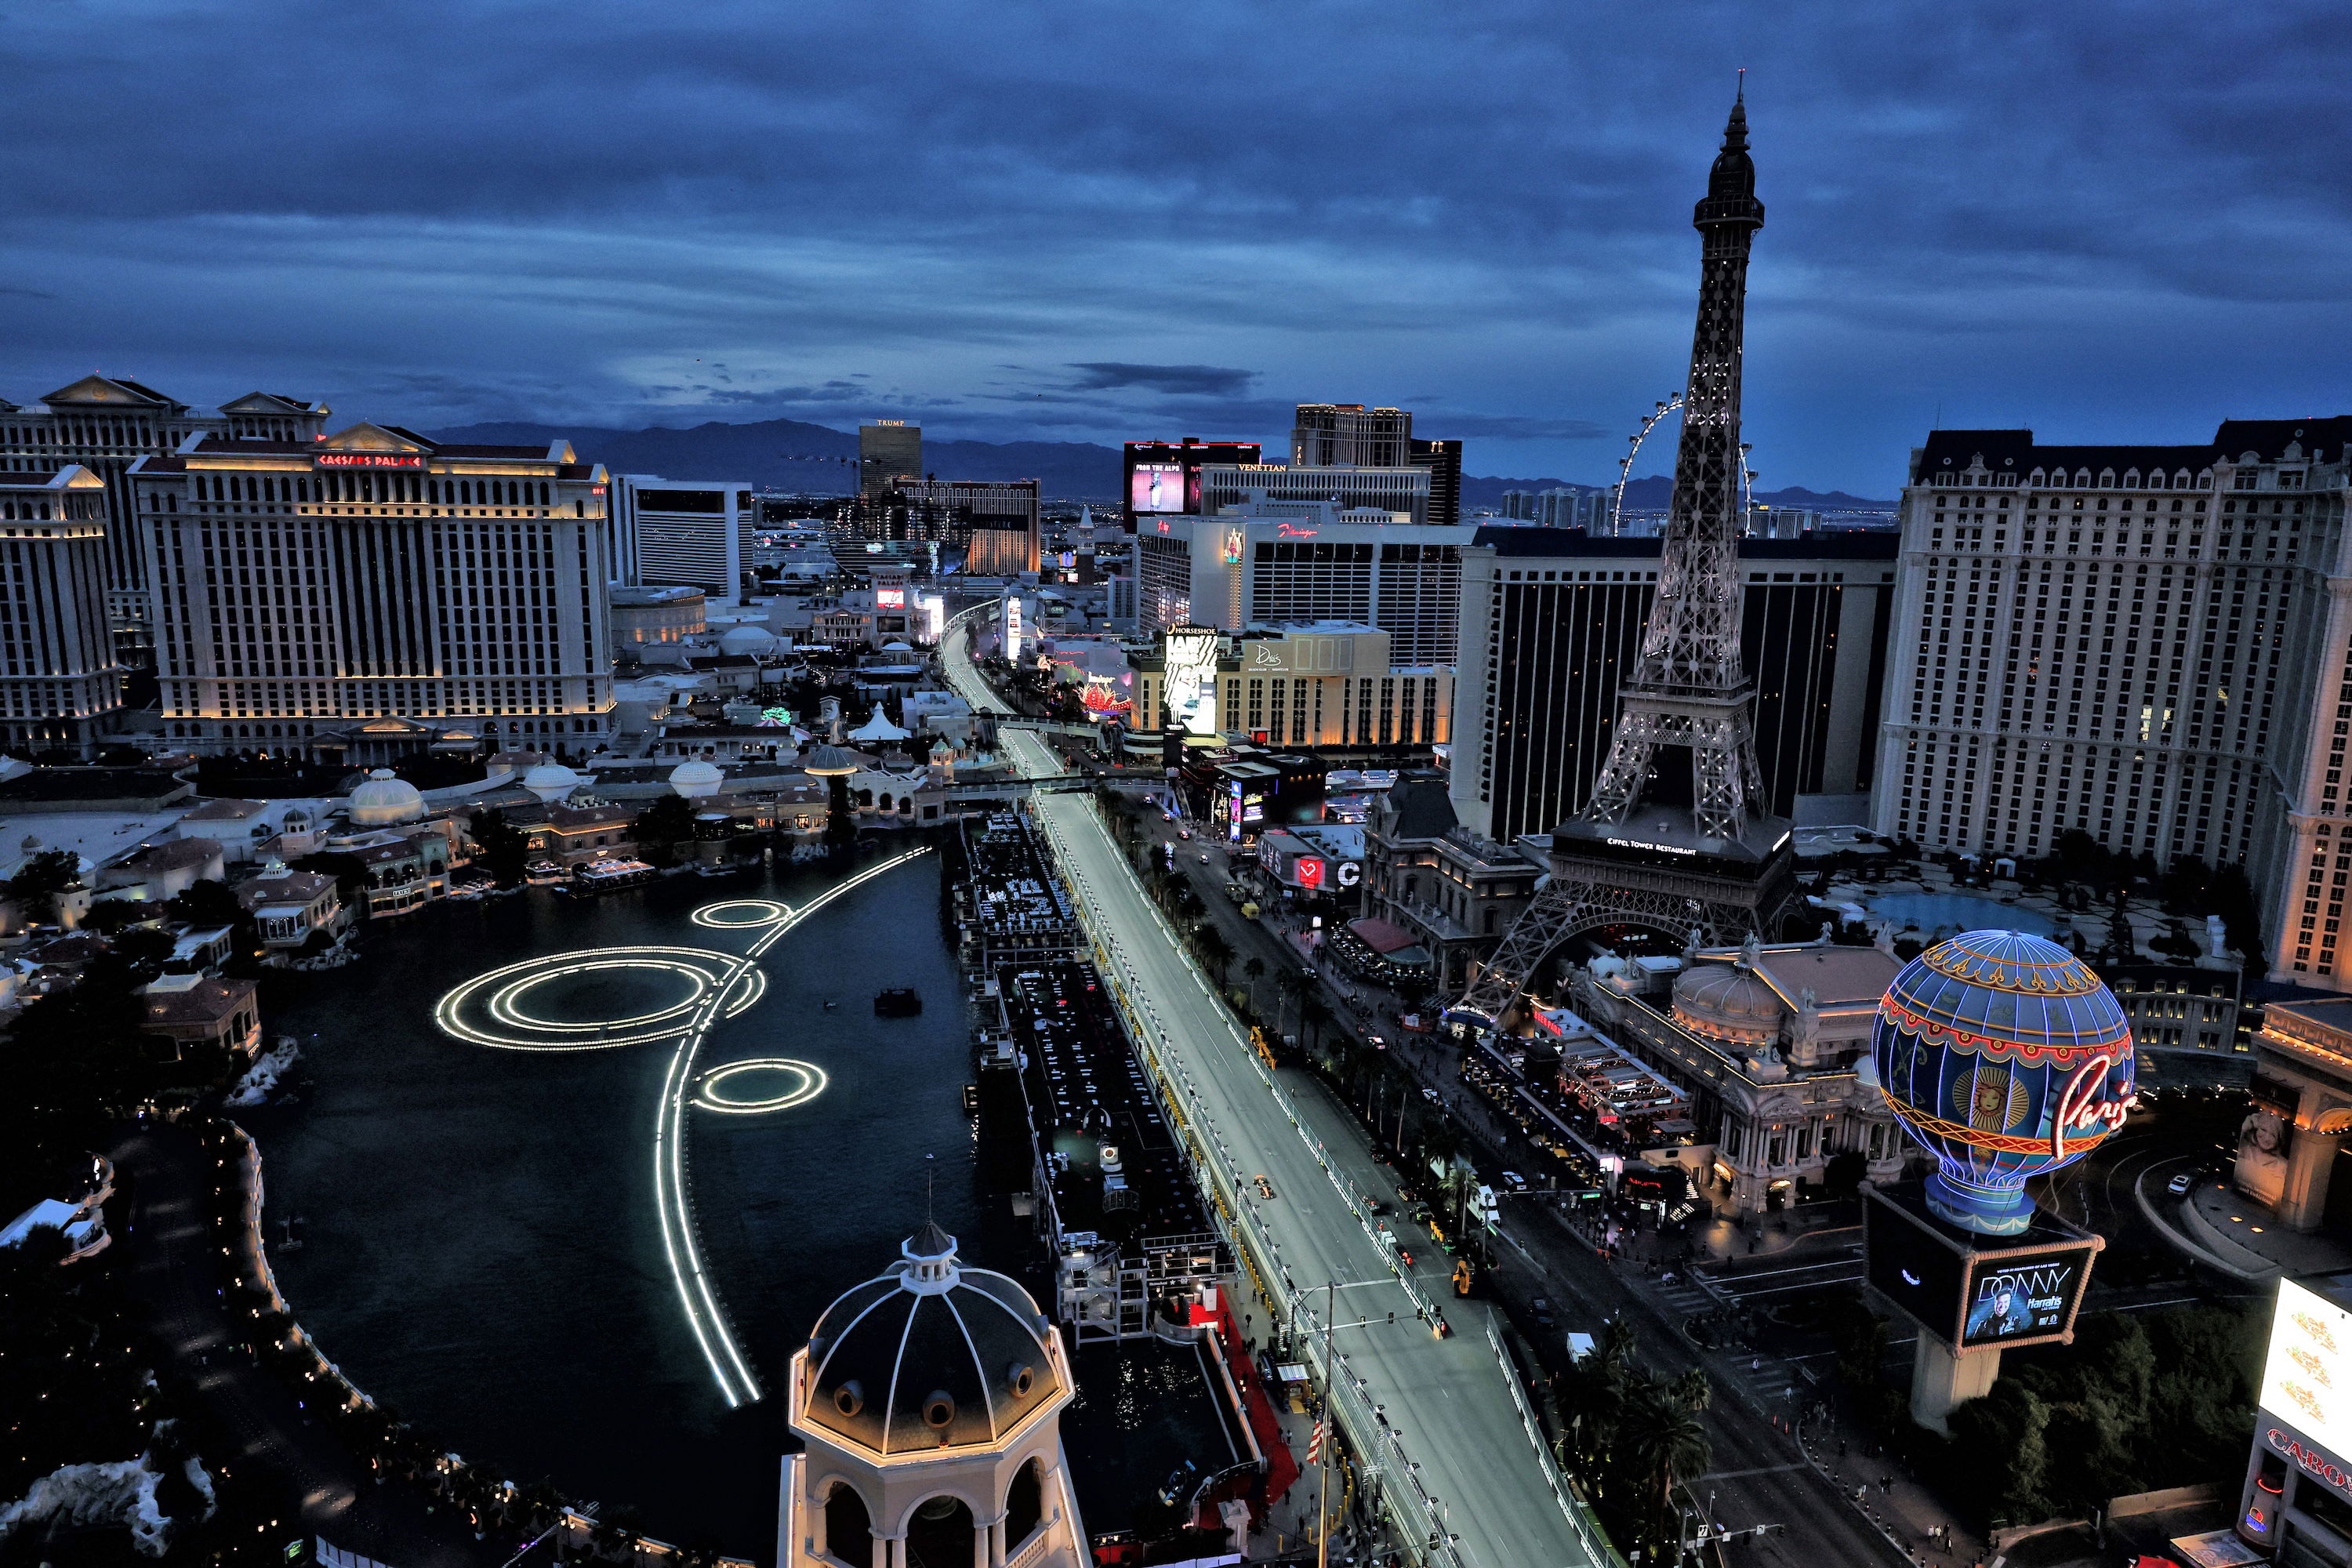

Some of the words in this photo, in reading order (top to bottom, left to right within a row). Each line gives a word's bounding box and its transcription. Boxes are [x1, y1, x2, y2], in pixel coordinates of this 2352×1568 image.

[318, 455, 372, 466] CAESARS
[375, 456, 421, 467] PALACE
[1256, 644, 1282, 666] Drai's
[1607, 837, 1629, 848] EIFFEL
[1630, 840, 1653, 851] TOWER
[1655, 843, 1697, 856] RESTAURANT
[1338, 862, 1360, 886] C
[1534, 1011, 1548, 1027] BEER
[1546, 1019, 1563, 1036] PARK
[2055, 1052, 2139, 1161] Paris
[1978, 1266, 2071, 1302] DONNY
[2267, 1428, 2346, 1487] CABO
